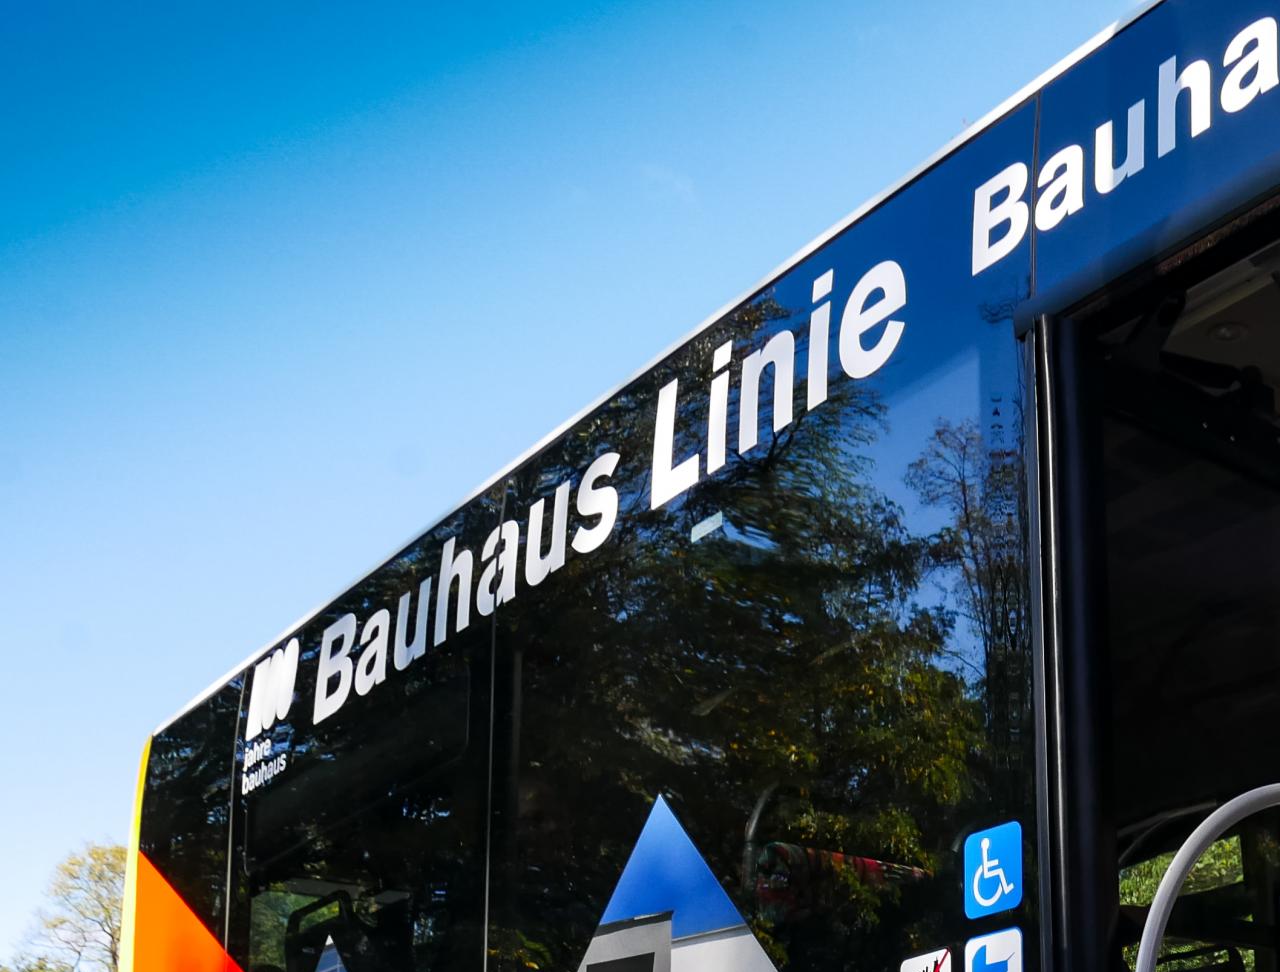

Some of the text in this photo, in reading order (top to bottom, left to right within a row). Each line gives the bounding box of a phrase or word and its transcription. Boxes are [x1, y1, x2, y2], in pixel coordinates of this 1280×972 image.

[313, 260, 906, 725] Bauhaus Linie
[241, 753, 287, 796] bauhaus
[243, 738, 272, 773] jahre
